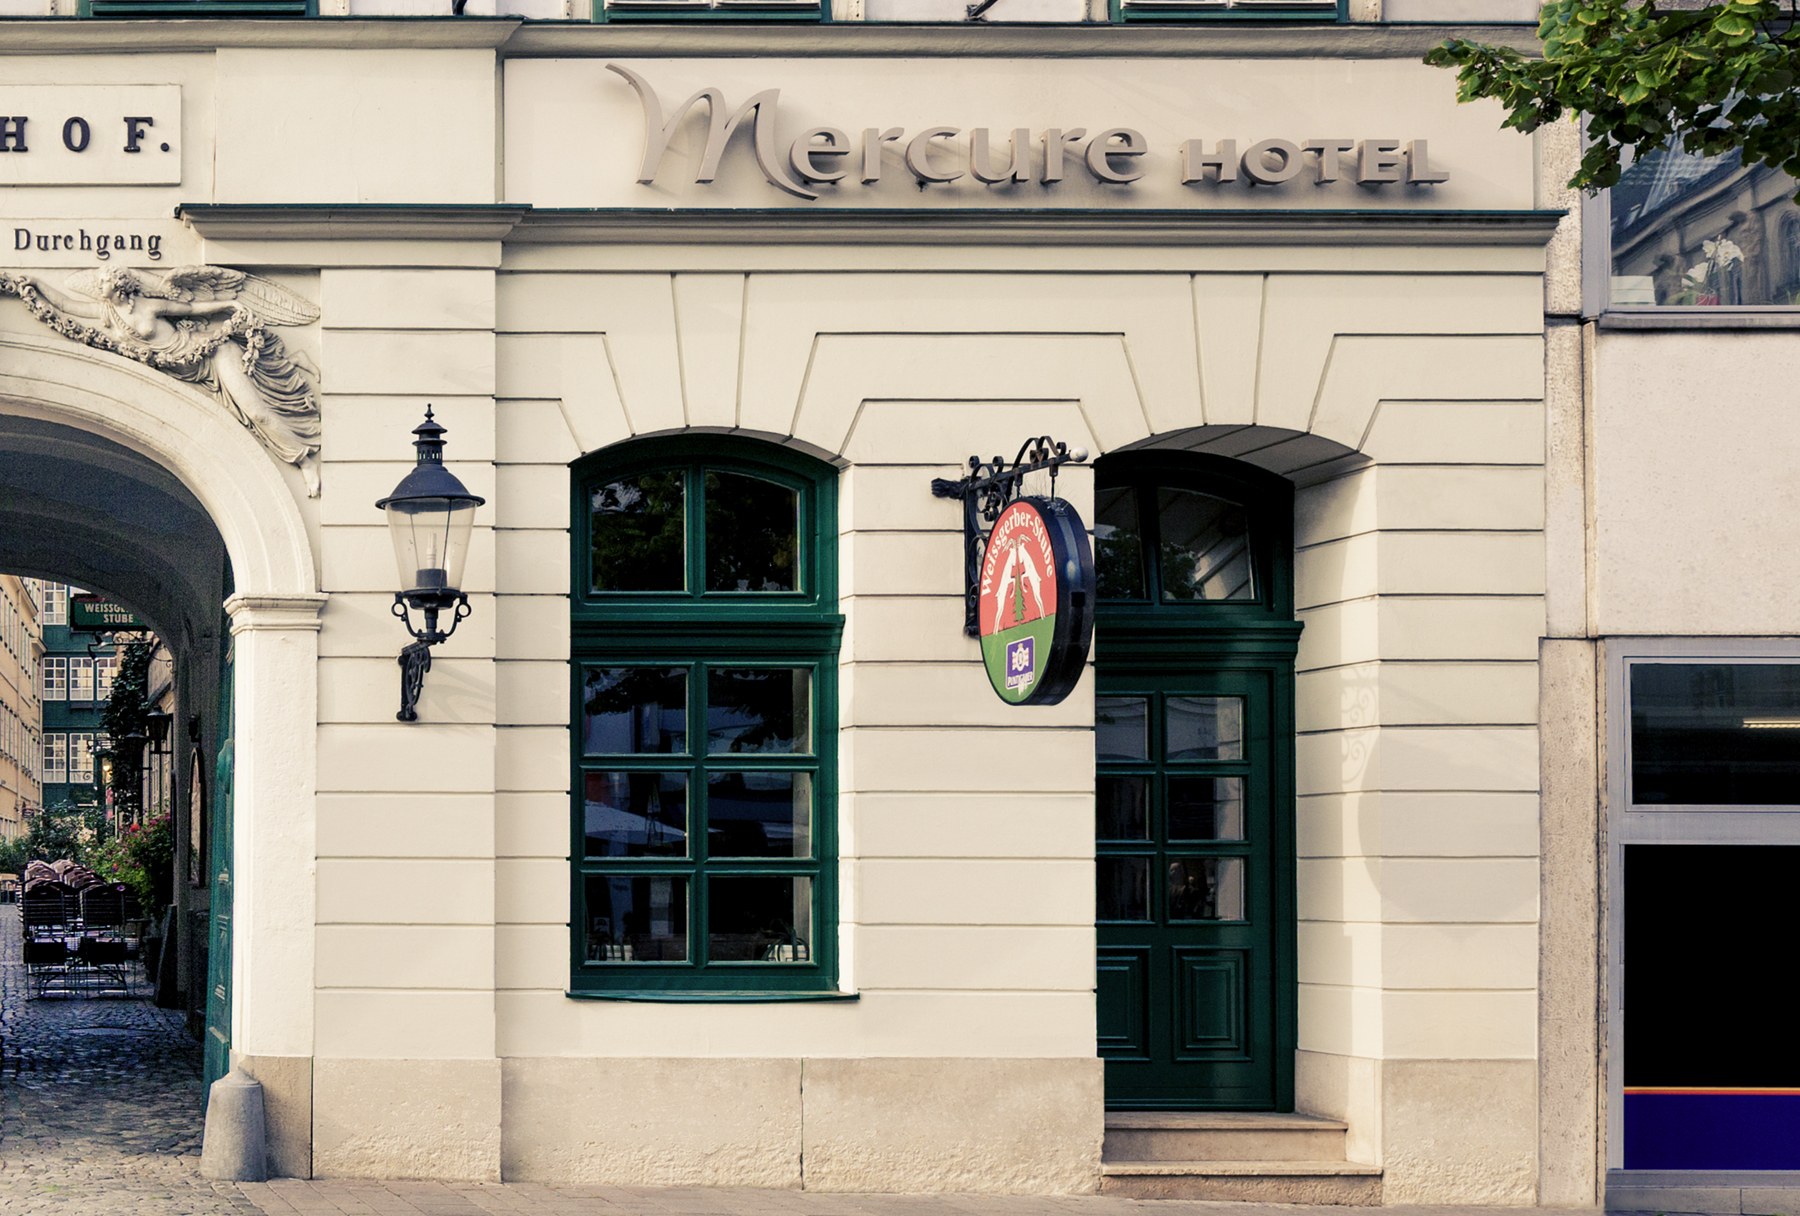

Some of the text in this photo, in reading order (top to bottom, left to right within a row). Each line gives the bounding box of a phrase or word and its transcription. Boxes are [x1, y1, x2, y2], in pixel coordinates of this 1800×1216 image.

[605, 62, 1452, 202] Mercure HOTEL
[13, 227, 163, 261] Durchgang
[981, 507, 1053, 597] Weissgerber-Stube
[84, 603, 129, 613] WEISSG
[103, 614, 134, 623] STUBE
